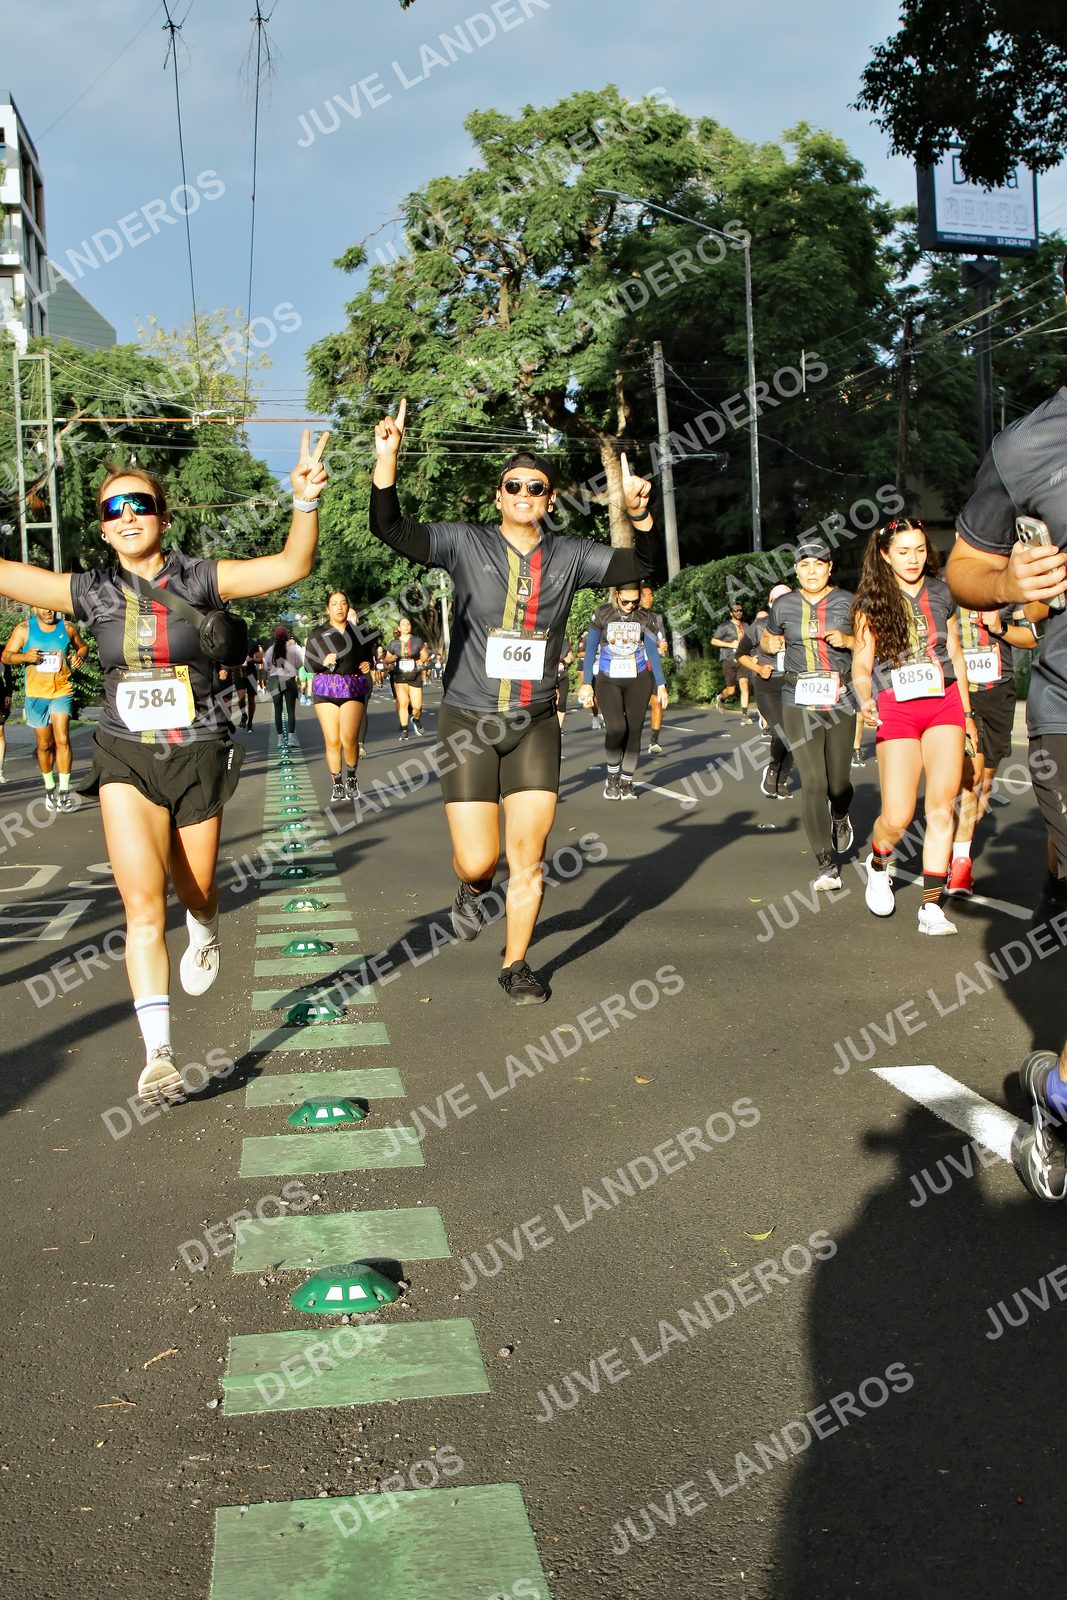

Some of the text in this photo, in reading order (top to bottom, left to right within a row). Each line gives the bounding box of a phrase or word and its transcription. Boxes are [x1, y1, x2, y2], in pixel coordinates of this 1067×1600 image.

[502, 645, 532, 663] 666
[964, 657, 993, 672] 046
[898, 667, 934, 685] 8856
[801, 681, 831, 695] 8024
[124, 687, 177, 710] 7584
